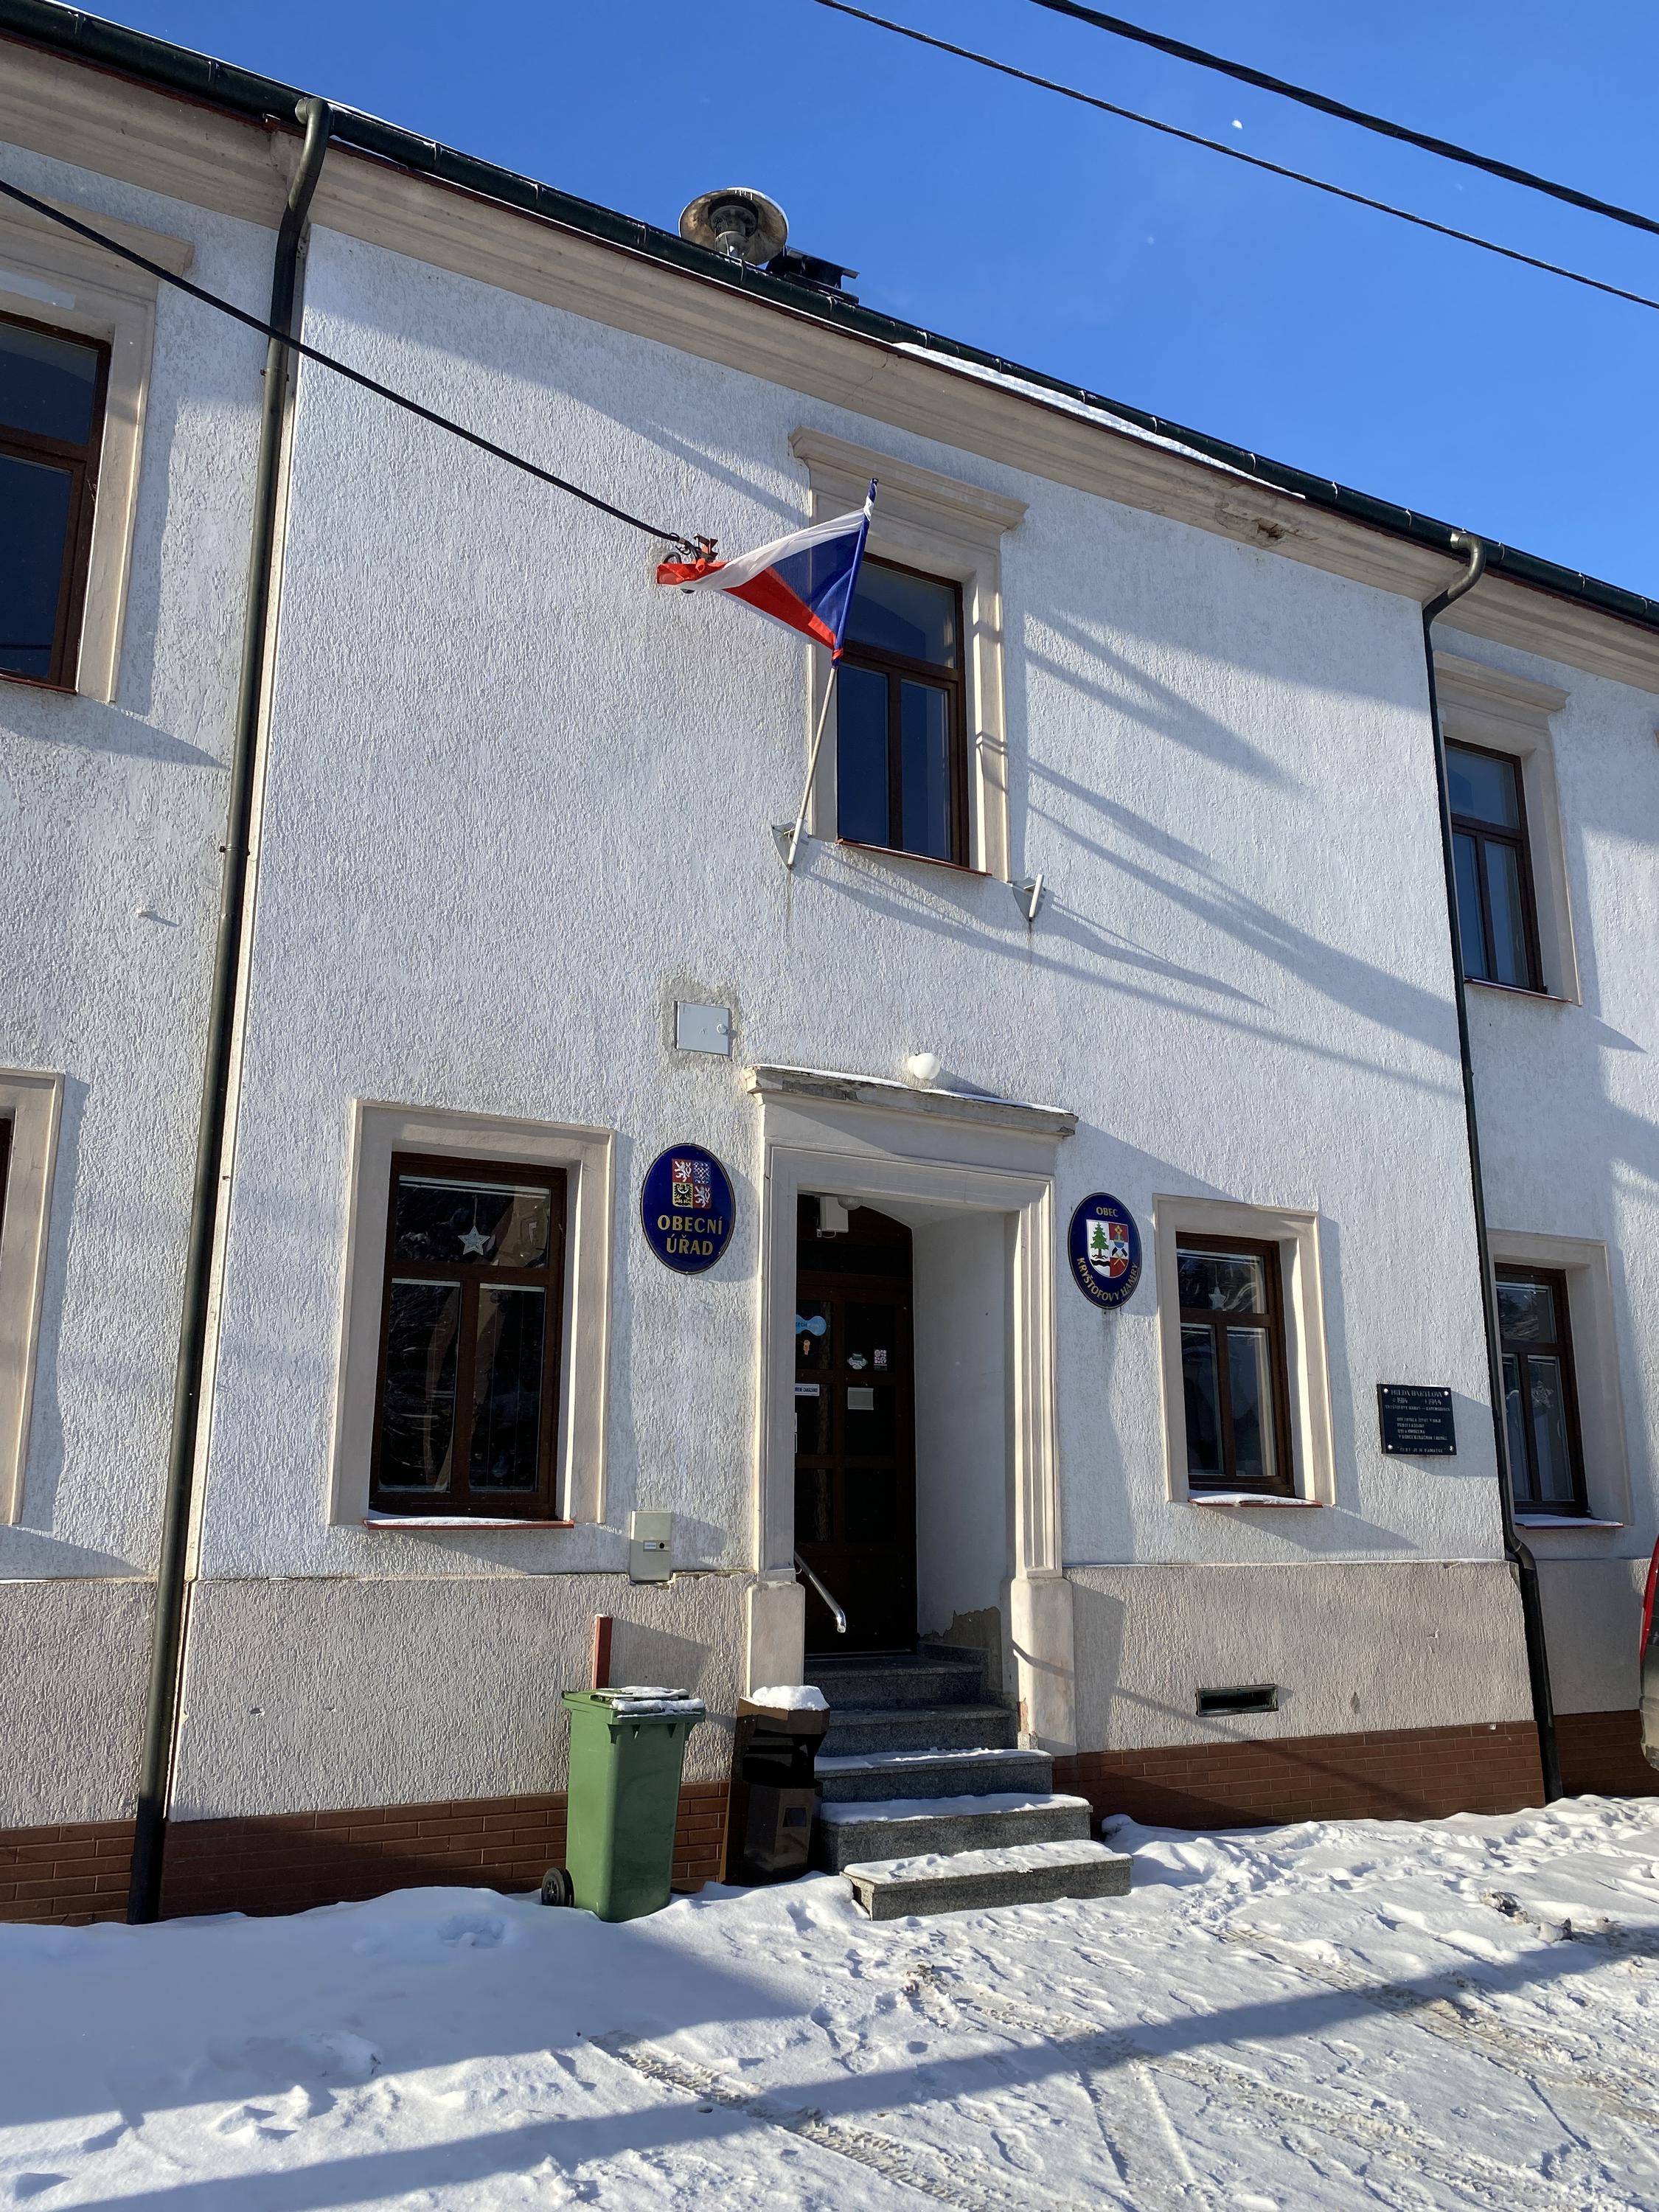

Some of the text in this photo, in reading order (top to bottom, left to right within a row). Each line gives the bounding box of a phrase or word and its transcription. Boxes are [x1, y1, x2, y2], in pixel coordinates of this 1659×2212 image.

[1096, 1206, 1119, 1217] OBEC
[657, 1214, 723, 1235] OBECNÍ
[666, 1234, 713, 1256] ÚŘAD
[1077, 1257, 1138, 1302] KRYŠTOFOVY HAMRY
